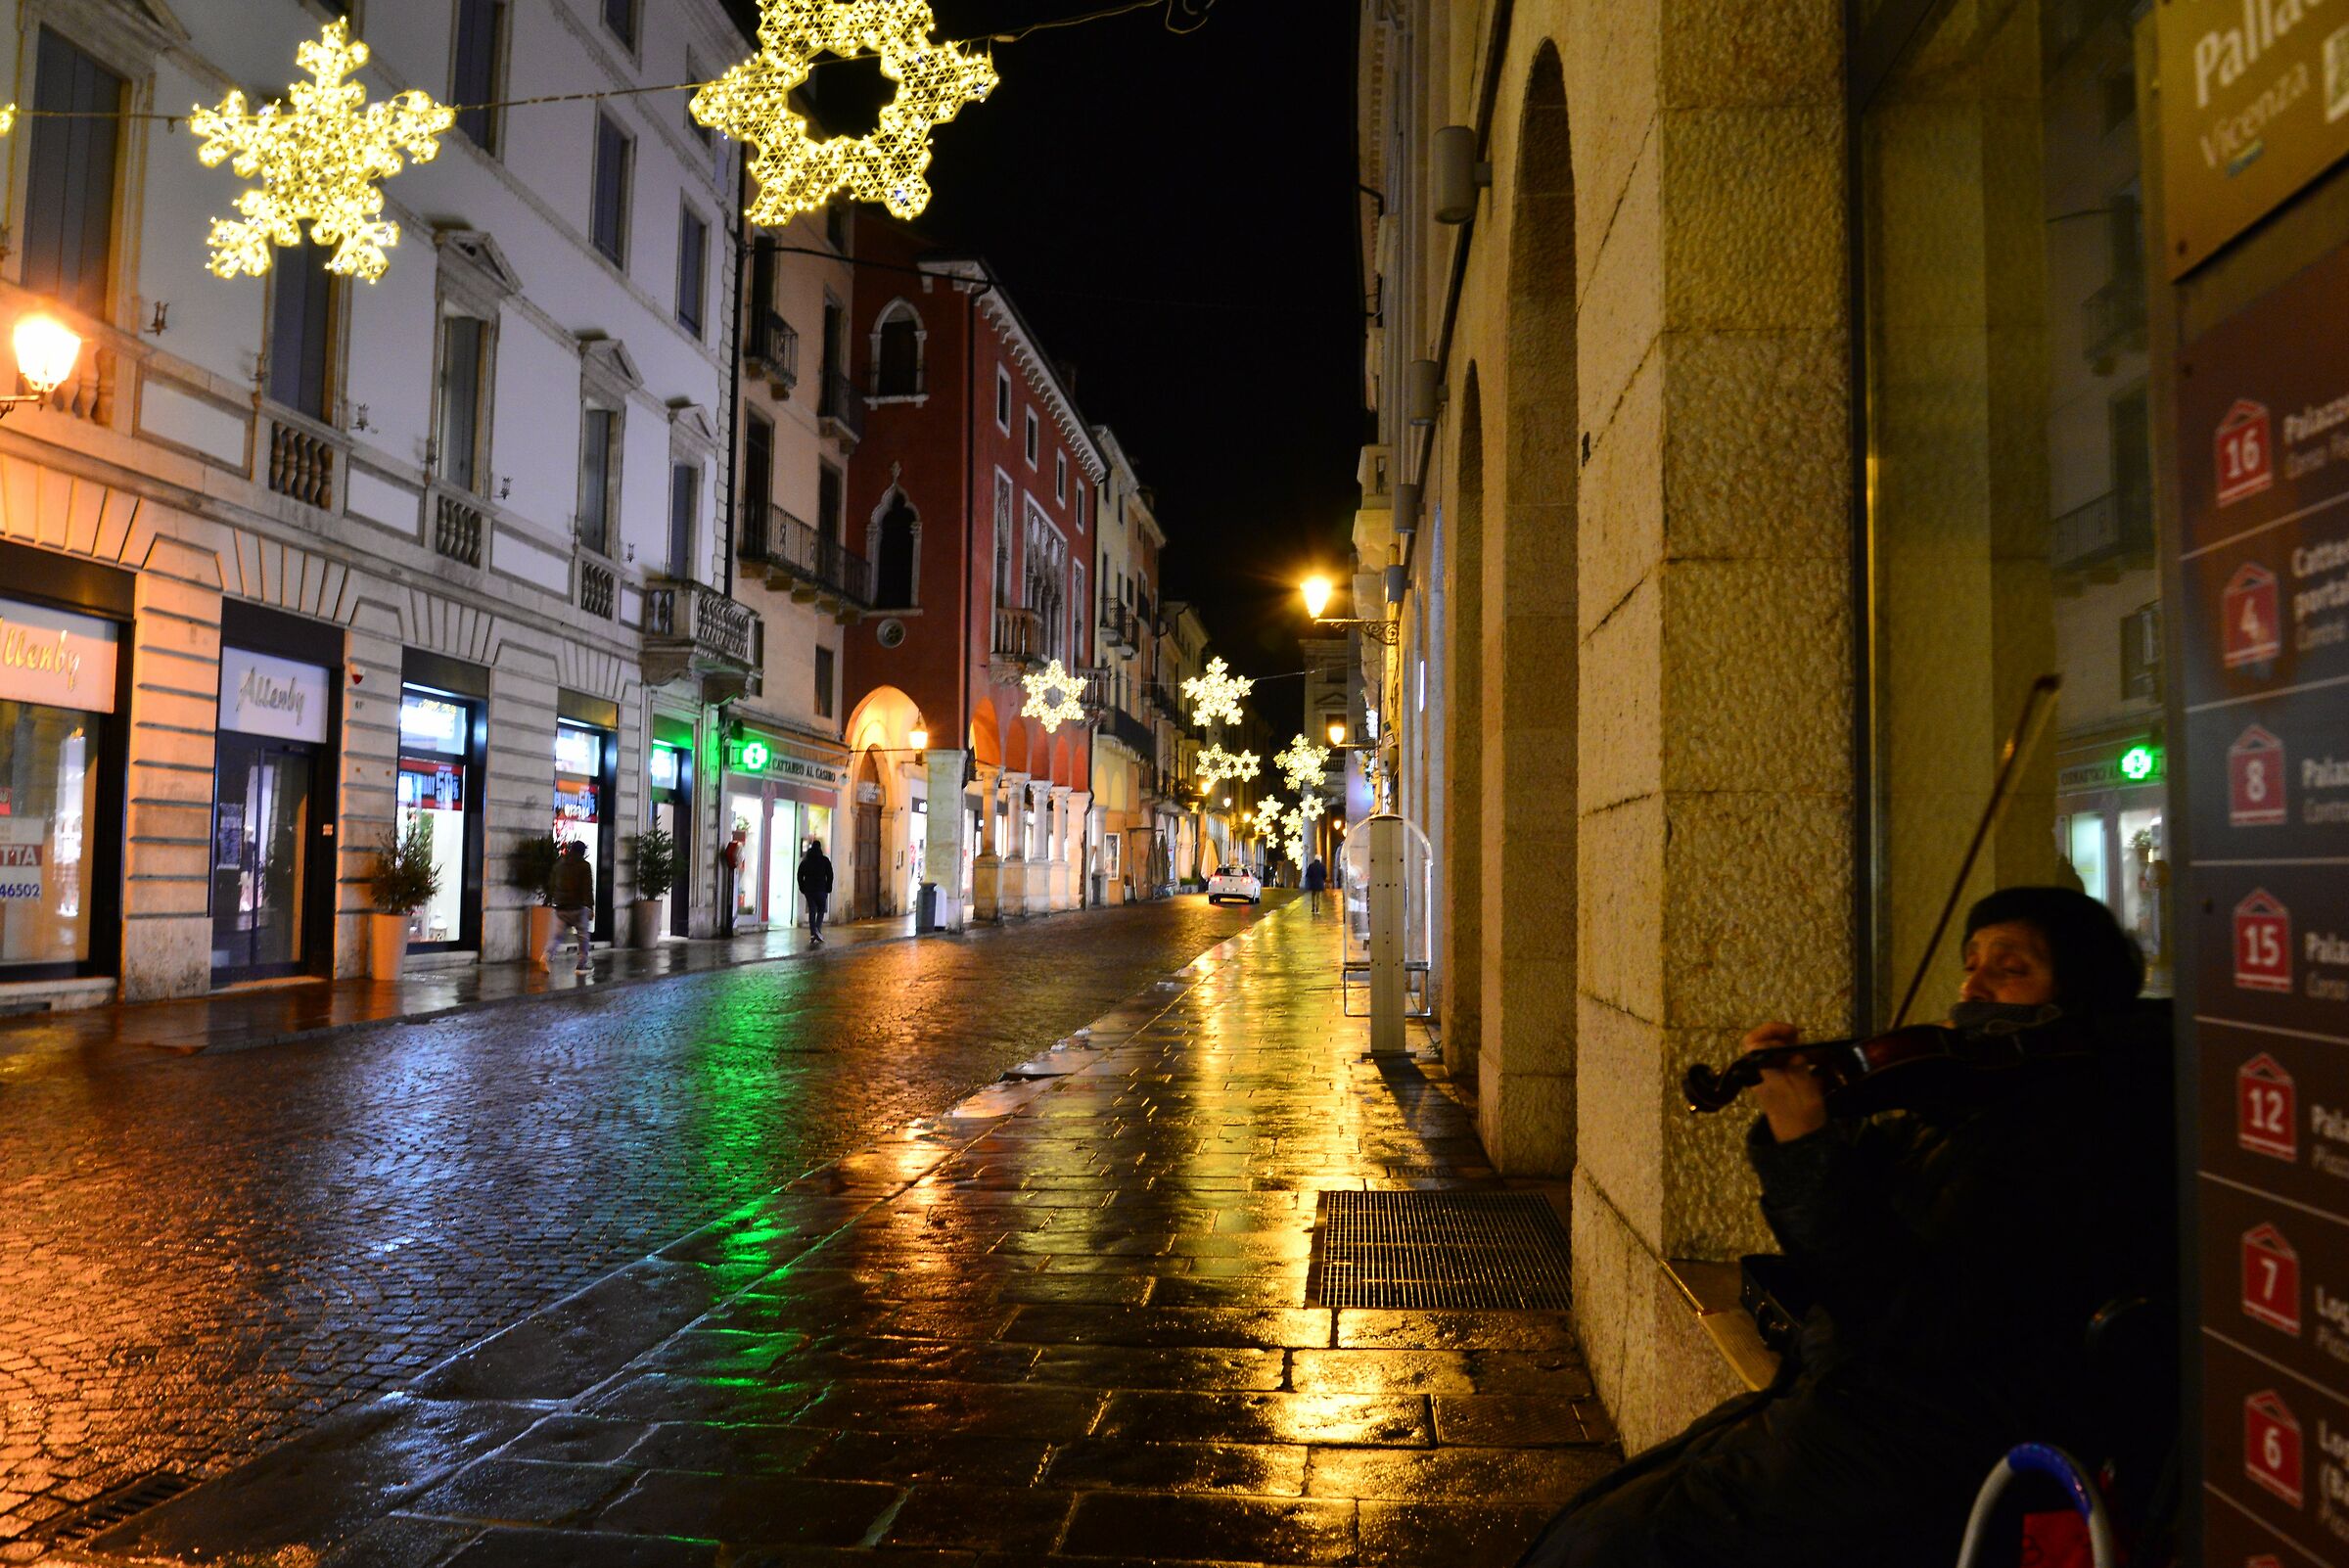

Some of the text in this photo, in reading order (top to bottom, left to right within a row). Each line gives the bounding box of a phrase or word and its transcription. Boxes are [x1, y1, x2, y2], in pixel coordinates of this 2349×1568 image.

[2194, 0, 2324, 108] Palla
[2199, 62, 2310, 168] Vicenza
[2226, 427, 2261, 480] 16
[2239, 596, 2261, 636] 4
[0, 616, 80, 693] llenby
[235, 666, 305, 726] Allenby
[2245, 759, 2267, 803] 8
[2244, 925, 2280, 967] 15
[2249, 1087, 2284, 1133] 12
[2261, 1257, 2279, 1302] 7
[2263, 1427, 2283, 1472] 6
